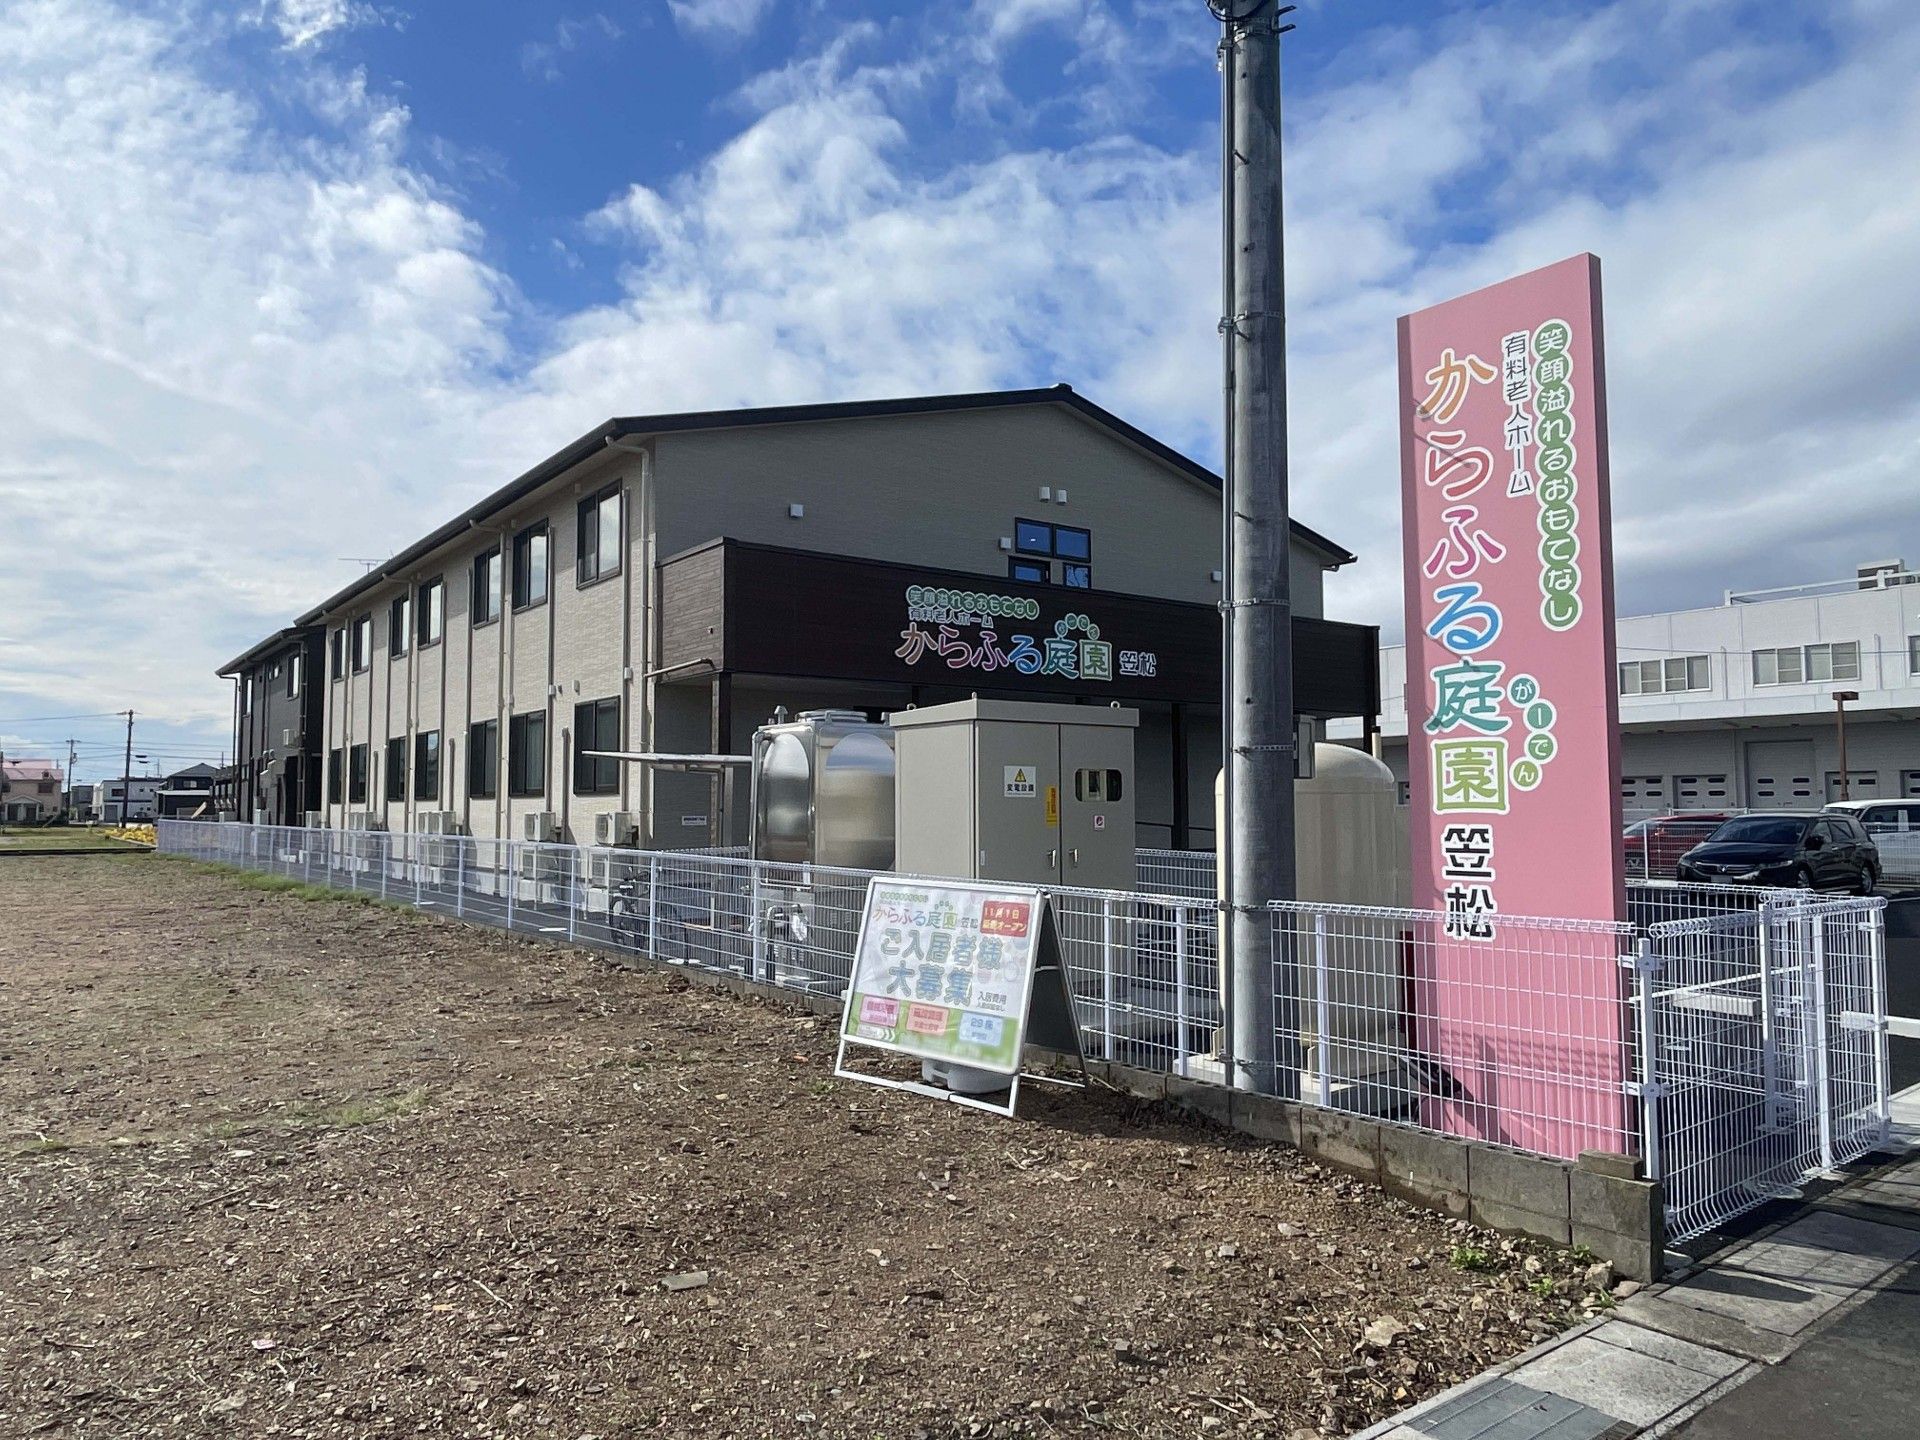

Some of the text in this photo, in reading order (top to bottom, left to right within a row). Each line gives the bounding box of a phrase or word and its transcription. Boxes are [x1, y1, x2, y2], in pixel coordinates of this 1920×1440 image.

[1504, 332, 1532, 495] 有料老人ホーム
[1536, 325, 1577, 624] 笑顔溢れるおもてなし
[907, 587, 1038, 619] 笑顔溢れるおもてなし
[1418, 351, 1509, 811] からふる庭園
[909, 606, 994, 628] 有料老人ホーム
[896, 622, 1112, 681] からふる庭園
[1120, 651, 1156, 677] 笠松
[1511, 678, 1555, 786] がーでん
[1443, 826, 1493, 938] 笠松
[880, 928, 1004, 971] ご入居者様
[886, 960, 973, 1007] 大募集
